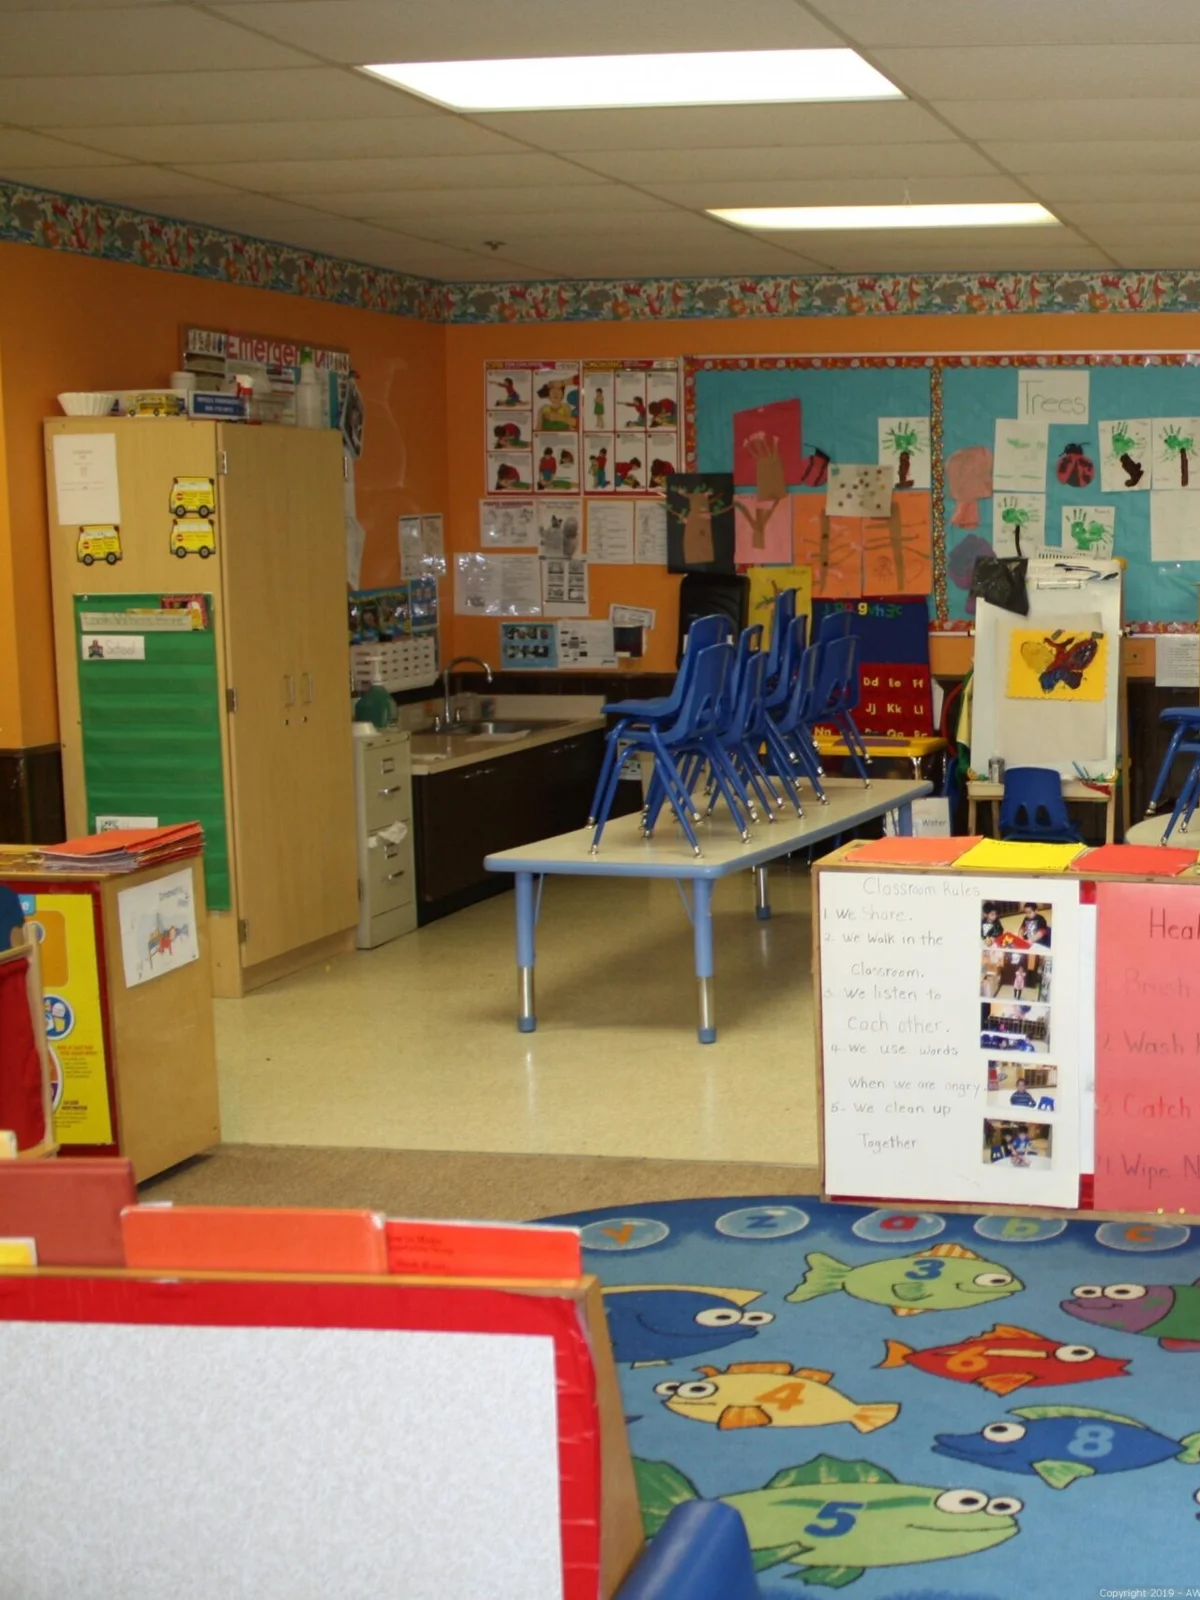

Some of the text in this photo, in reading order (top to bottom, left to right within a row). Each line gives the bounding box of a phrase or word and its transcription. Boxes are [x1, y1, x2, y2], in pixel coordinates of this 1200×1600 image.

[1019, 379, 1087, 415] Trees
[863, 677, 879, 687] Dd
[887, 704, 902, 713] Kk
[922, 819, 948, 827] Water
[863, 876, 981, 897] Classroom Rules
[836, 908, 856, 920] We
[902, 934, 915, 944] in
[921, 931, 943, 946] the
[845, 987, 866, 999] We
[873, 984, 918, 1001] listen
[927, 988, 941, 1000] to
[880, 1044, 907, 1055] use
[1123, 1028, 1185, 1055] Wash
[918, 1079, 936, 1090] are
[853, 1101, 874, 1114] We
[885, 1100, 925, 1114] clean
[933, 1105, 951, 1118] up
[1123, 1095, 1191, 1120] Catch
[858, 1132, 917, 1154] Together
[879, 1214, 922, 1231] a
[1002, 1217, 1040, 1236] b
[1125, 1226, 1157, 1242] c
[905, 1259, 944, 1280] 3
[944, 1347, 990, 1373] 6
[754, 1382, 808, 1411] 4
[1066, 1424, 1114, 1458] 8
[803, 1500, 867, 1539] 5
